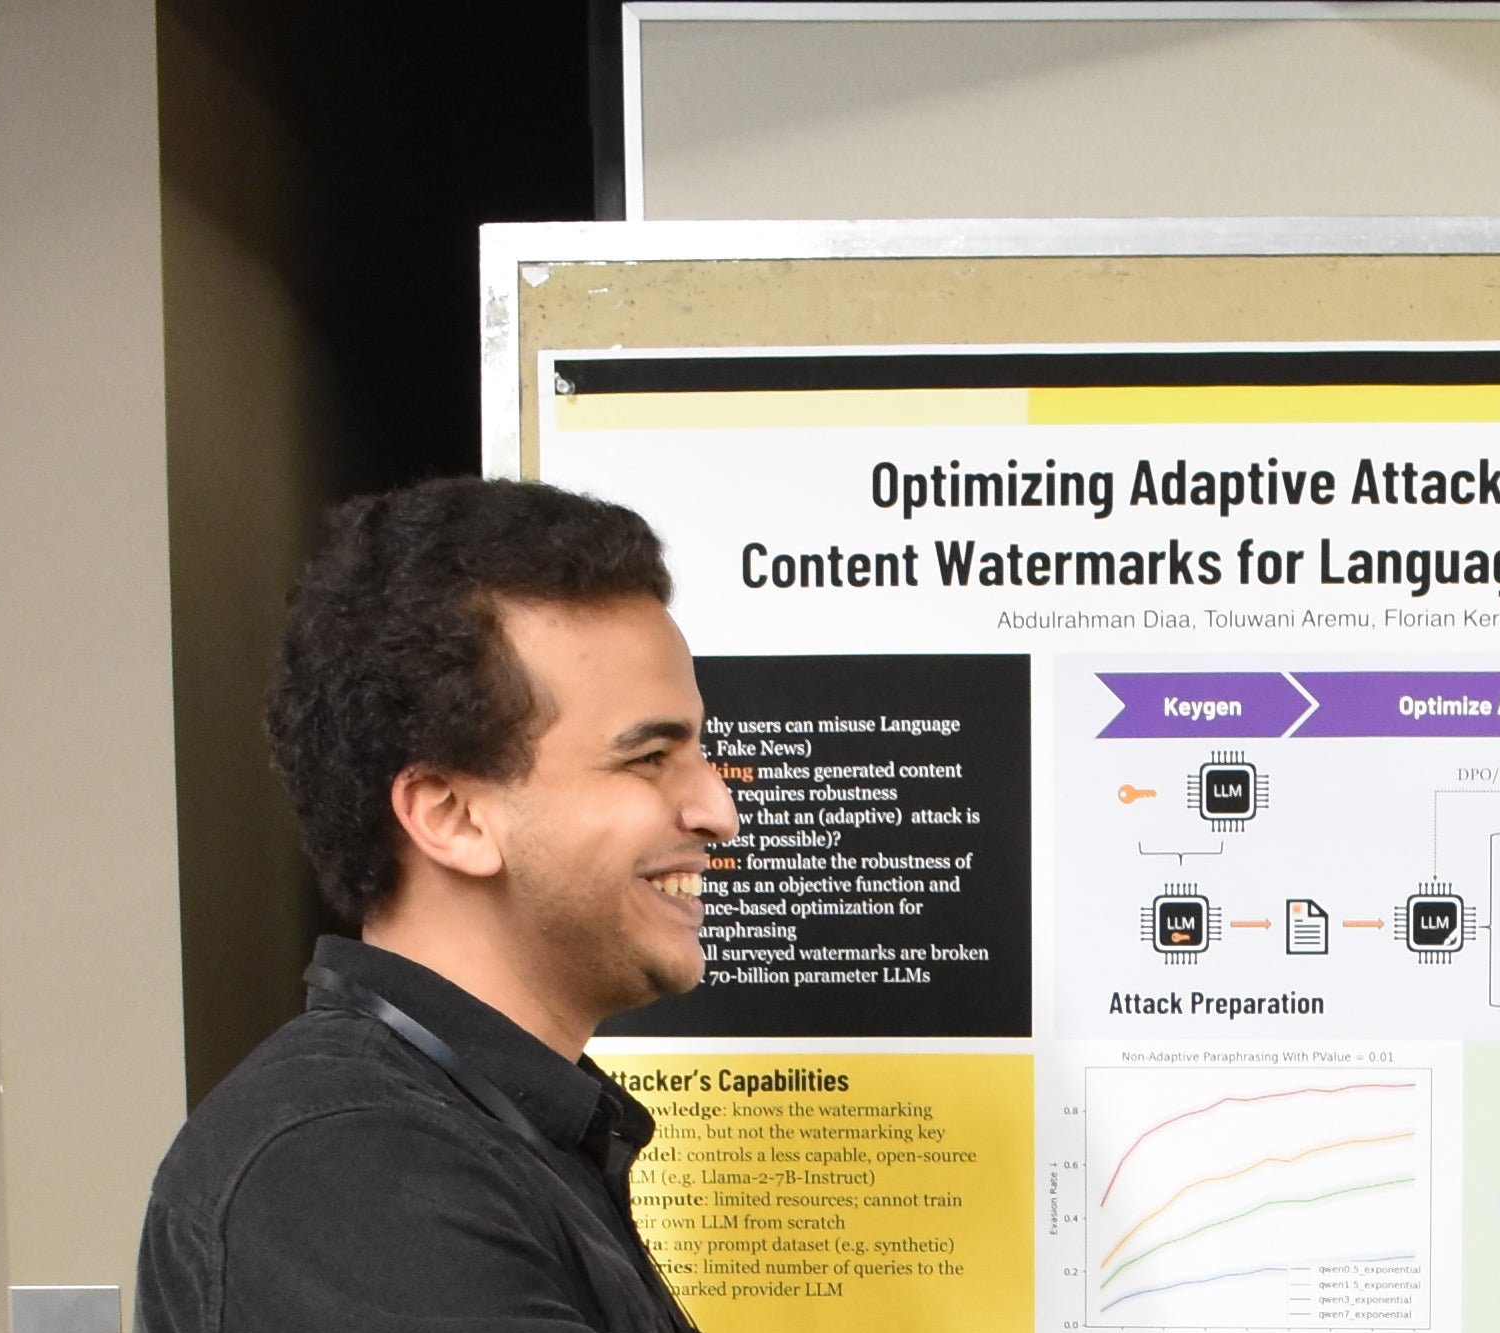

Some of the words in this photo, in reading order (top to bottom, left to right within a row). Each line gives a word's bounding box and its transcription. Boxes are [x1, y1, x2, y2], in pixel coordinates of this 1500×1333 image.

[872, 458, 1114, 520] Optimizing
[1129, 456, 1336, 518] Adaptive
[742, 542, 919, 589] Content
[934, 538, 1222, 587] Watermarks
[1236, 538, 1305, 585] for
[997, 610, 1135, 629] Abdulrahman
[1143, 609, 1196, 630] Diaa,
[1203, 609, 1295, 629] Toluwani
[1301, 609, 1376, 629] Aremu,
[1384, 608, 1455, 628] Florian
[1164, 696, 1242, 721] Keygen
[1398, 695, 1493, 720] Optimize
[737, 721, 782, 734] users
[785, 720, 814, 734] can
[818, 715, 876, 733] misuse
[880, 715, 961, 736] Language
[1213, 783, 1242, 798] LLM
[746, 852, 827, 870] formulate
[830, 852, 857, 870] the
[860, 851, 951, 870] robustness
[954, 851, 974, 870] of
[732, 881, 751, 893] as
[754, 880, 775, 894] an
[778, 875, 852, 897] objective
[855, 875, 925, 893] function
[928, 875, 961, 893] and
[1167, 916, 1195, 931] LLM
[1420, 915, 1450, 930] LLM
[721, 943, 796, 965] surveyed
[798, 943, 896, 961] watermarks
[899, 948, 927, 961] are
[930, 943, 989, 961] broken
[709, 966, 790, 986] 70-billion
[794, 968, 879, 988] parameter
[882, 967, 931, 983] LLMs
[1109, 991, 1183, 1015] Attack
[1191, 990, 1324, 1021] Preparation
[1122, 1051, 1200, 1064] Non-Adaptive
[1203, 1051, 1279, 1065] Paraphrasing
[1282, 1051, 1309, 1062] With
[1312, 1051, 1352, 1062] PValue
[1368, 1051, 1393, 1063] 0.01
[719, 1069, 849, 1096] Capabilities
[1063, 1106, 1079, 1115] 0.8
[636, 1148, 682, 1163] odel:
[687, 1148, 751, 1163] controls
[758, 1152, 765, 1163] a
[771, 1148, 800, 1163] less
[805, 1148, 871, 1166] capable,
[876, 1150, 977, 1166] open-source
[1063, 1161, 1079, 1170] 0.6
[714, 1192, 770, 1207] limited
[777, 1194, 858, 1209] resources;
[864, 1193, 918, 1207] cannot
[924, 1193, 962, 1207] train
[1063, 1214, 1079, 1223] 0.4
[1063, 1267, 1079, 1277] 0.2
[1063, 1321, 1079, 1330] 0.0
